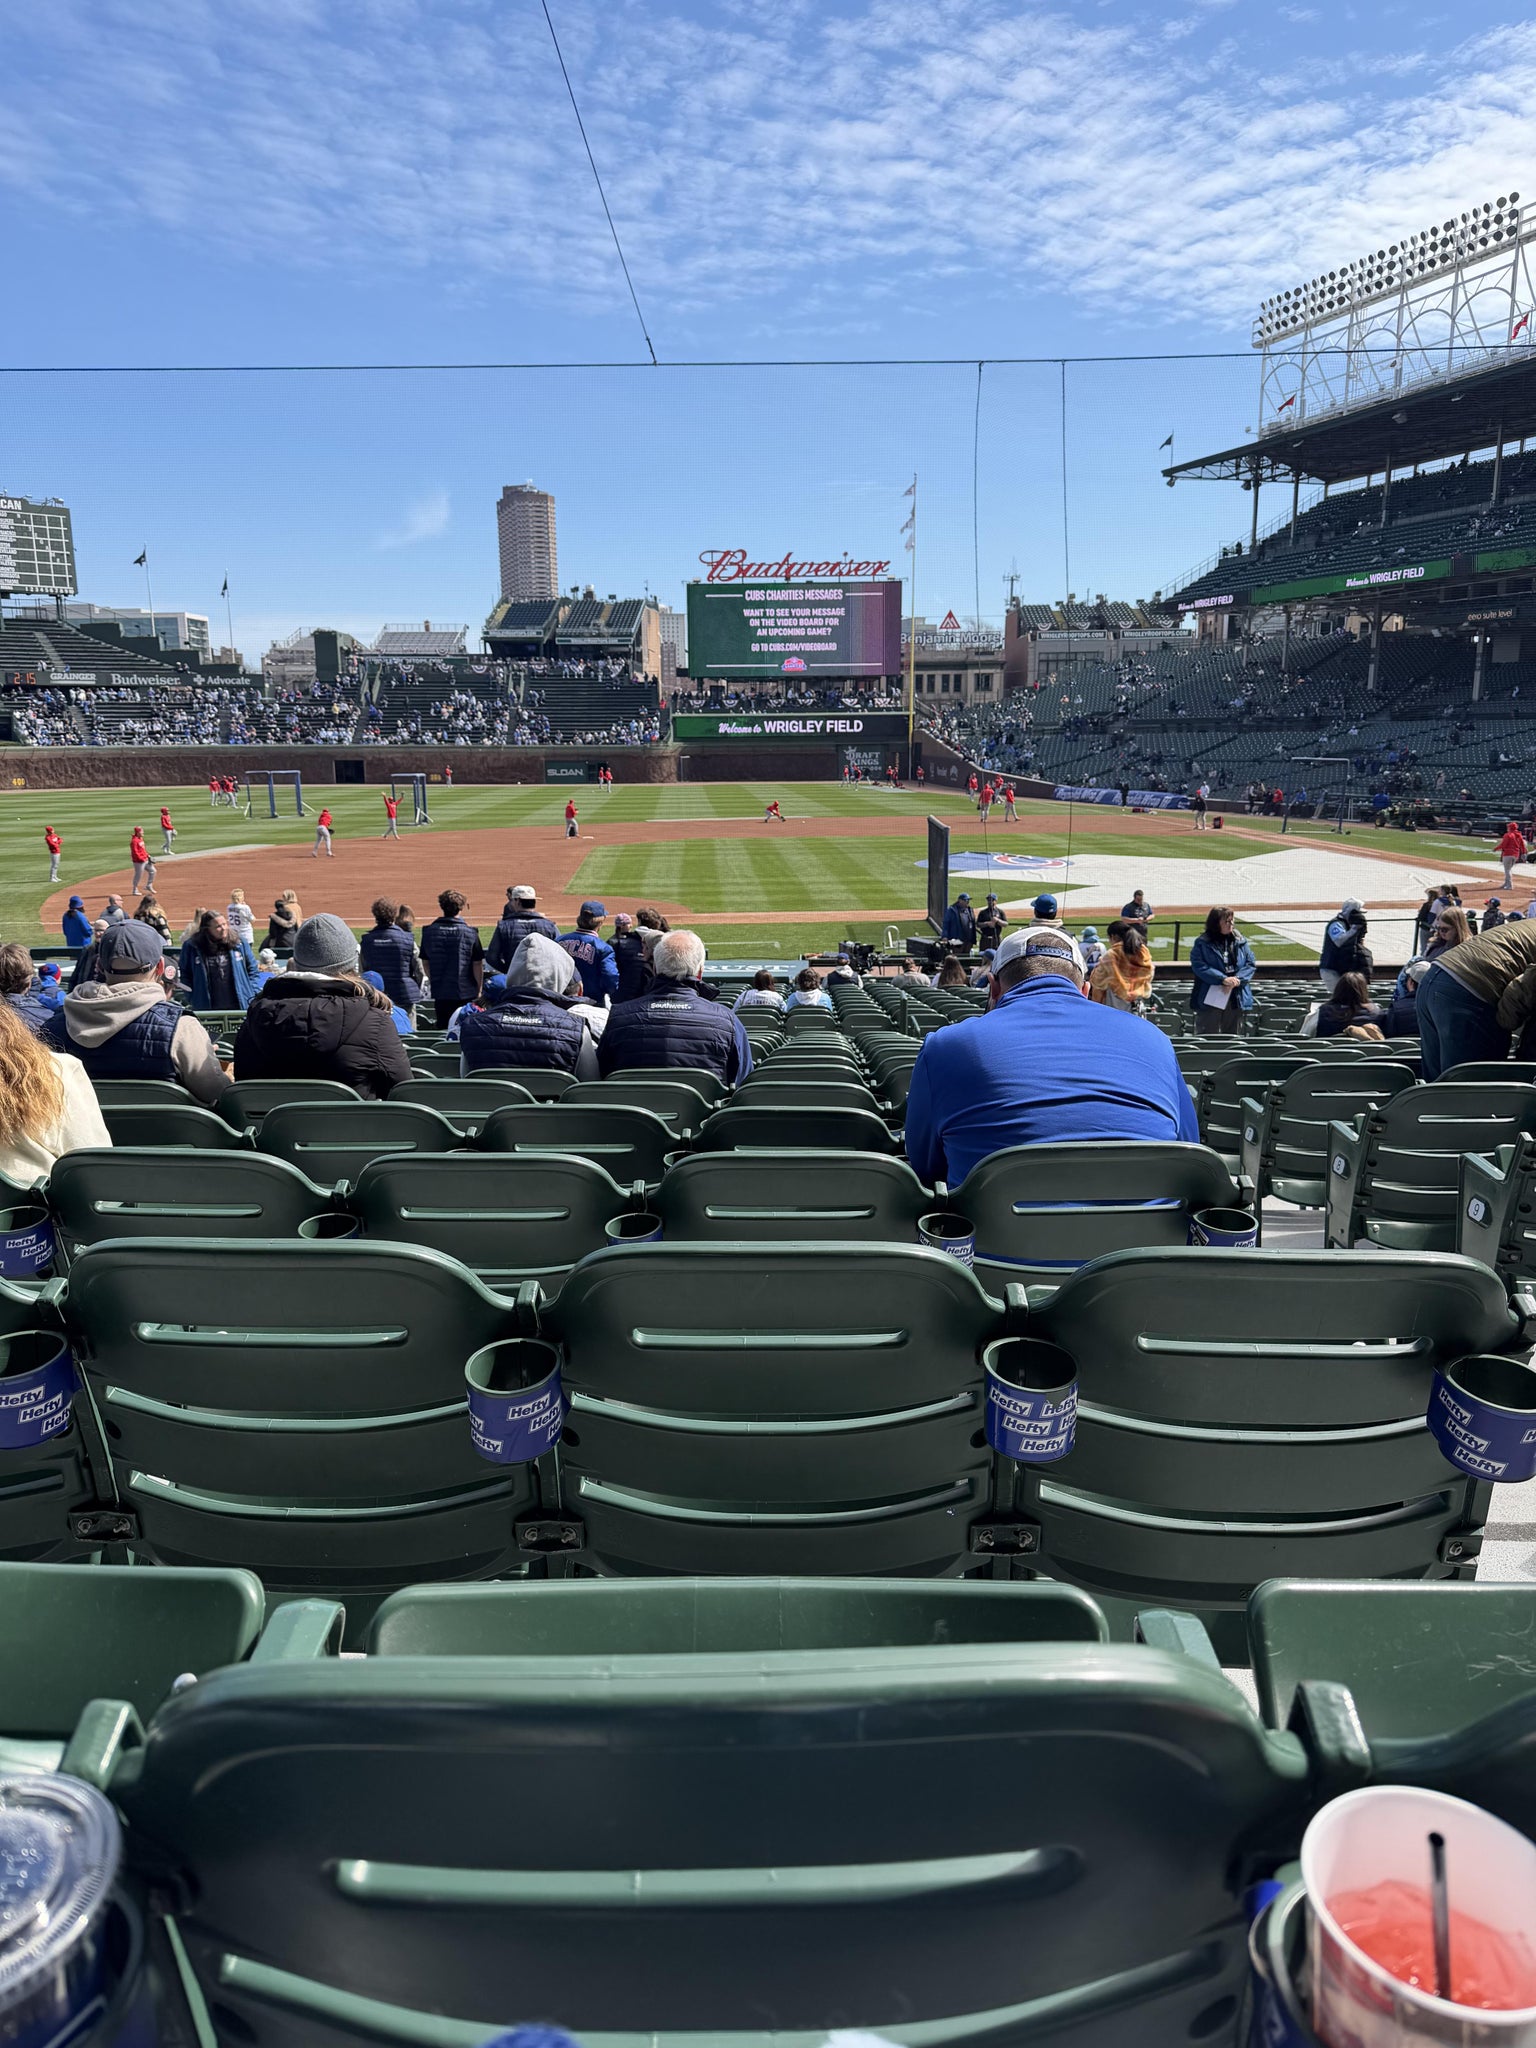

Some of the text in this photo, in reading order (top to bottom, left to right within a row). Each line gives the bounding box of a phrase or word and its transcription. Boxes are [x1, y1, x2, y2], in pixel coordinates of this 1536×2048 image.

[699, 549, 891, 582] Budweiser
[1370, 570, 1402, 584] WRIGLEY
[1403, 567, 1424, 579] FIELD
[745, 589, 843, 601] CUBS CHARITIES MESSAGES
[1217, 595, 1233, 605] FIELD
[743, 607, 845, 617] WANT TO SEE YOUR MESSAGE
[749, 617, 840, 627] ON THE VIDEO BOARD FOR
[756, 627, 832, 636] AN UPCOMING GAME?
[901, 631, 1000, 646] Benjamin Moore
[751, 643, 760, 652] GO
[761, 643, 768, 651] TO
[50, 673, 96, 681] GRAINGER
[207, 676, 250, 685] Advocate
[718, 719, 863, 734] Welcome to WRIGLEY FIELD
[847, 751, 880, 760] DRAFT
[850, 759, 879, 767] KINGS
[229, 914, 241, 926] 26
[650, 1002, 689, 1010] Southwest
[502, 1015, 540, 1024] Southwest
[1473, 1203, 1480, 1216] 9
[8, 1236, 35, 1247] Hefty
[23, 1242, 46, 1256] Hefty
[0, 1390, 41, 1406] Hefty
[992, 1390, 1028, 1415] Hefty
[22, 1398, 61, 1420] Hefty
[511, 1397, 549, 1418] Hefty
[1441, 1390, 1467, 1421] Hefty
[1005, 1417, 1049, 1435] Hefty
[472, 1430, 499, 1452] Hefty
[1447, 1420, 1485, 1450] Hefty
[1023, 1439, 1064, 1451] Hefty
[1456, 1448, 1502, 1475] Hefty
